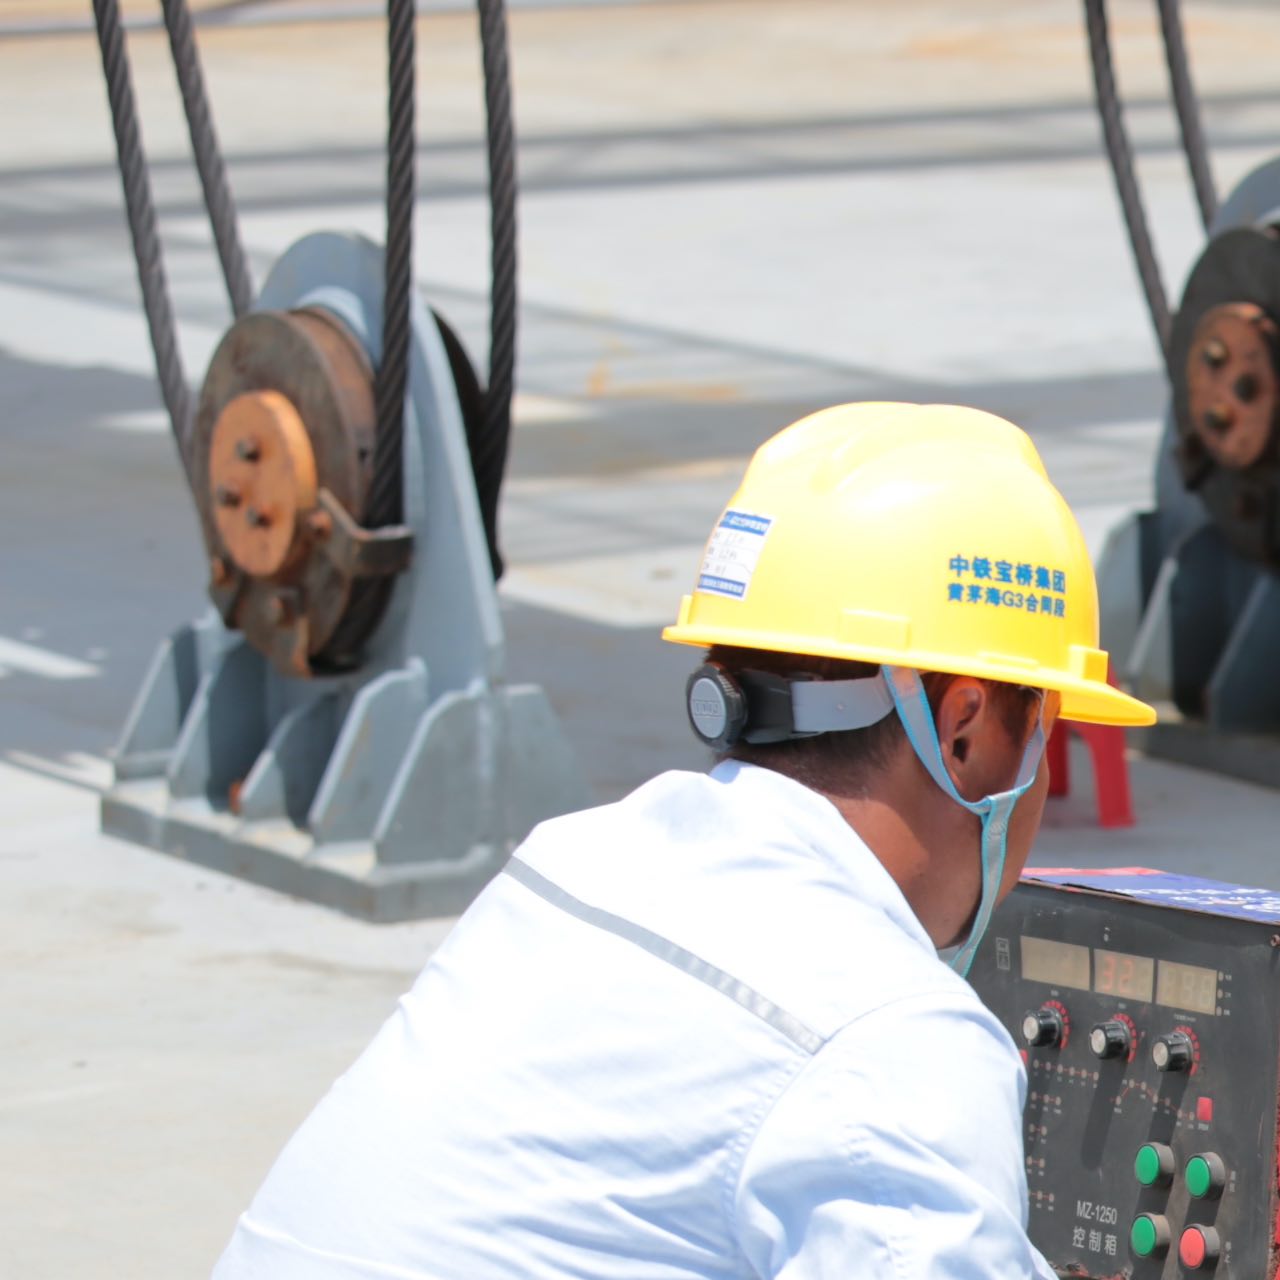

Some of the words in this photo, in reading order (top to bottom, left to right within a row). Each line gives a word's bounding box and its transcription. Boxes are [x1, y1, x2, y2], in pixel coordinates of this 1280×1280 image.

[949, 554, 1066, 595] 中铁宝桥集团
[1076, 1200, 1118, 1225] MZ-1250
[1072, 1226, 1118, 1256] 控制箱
